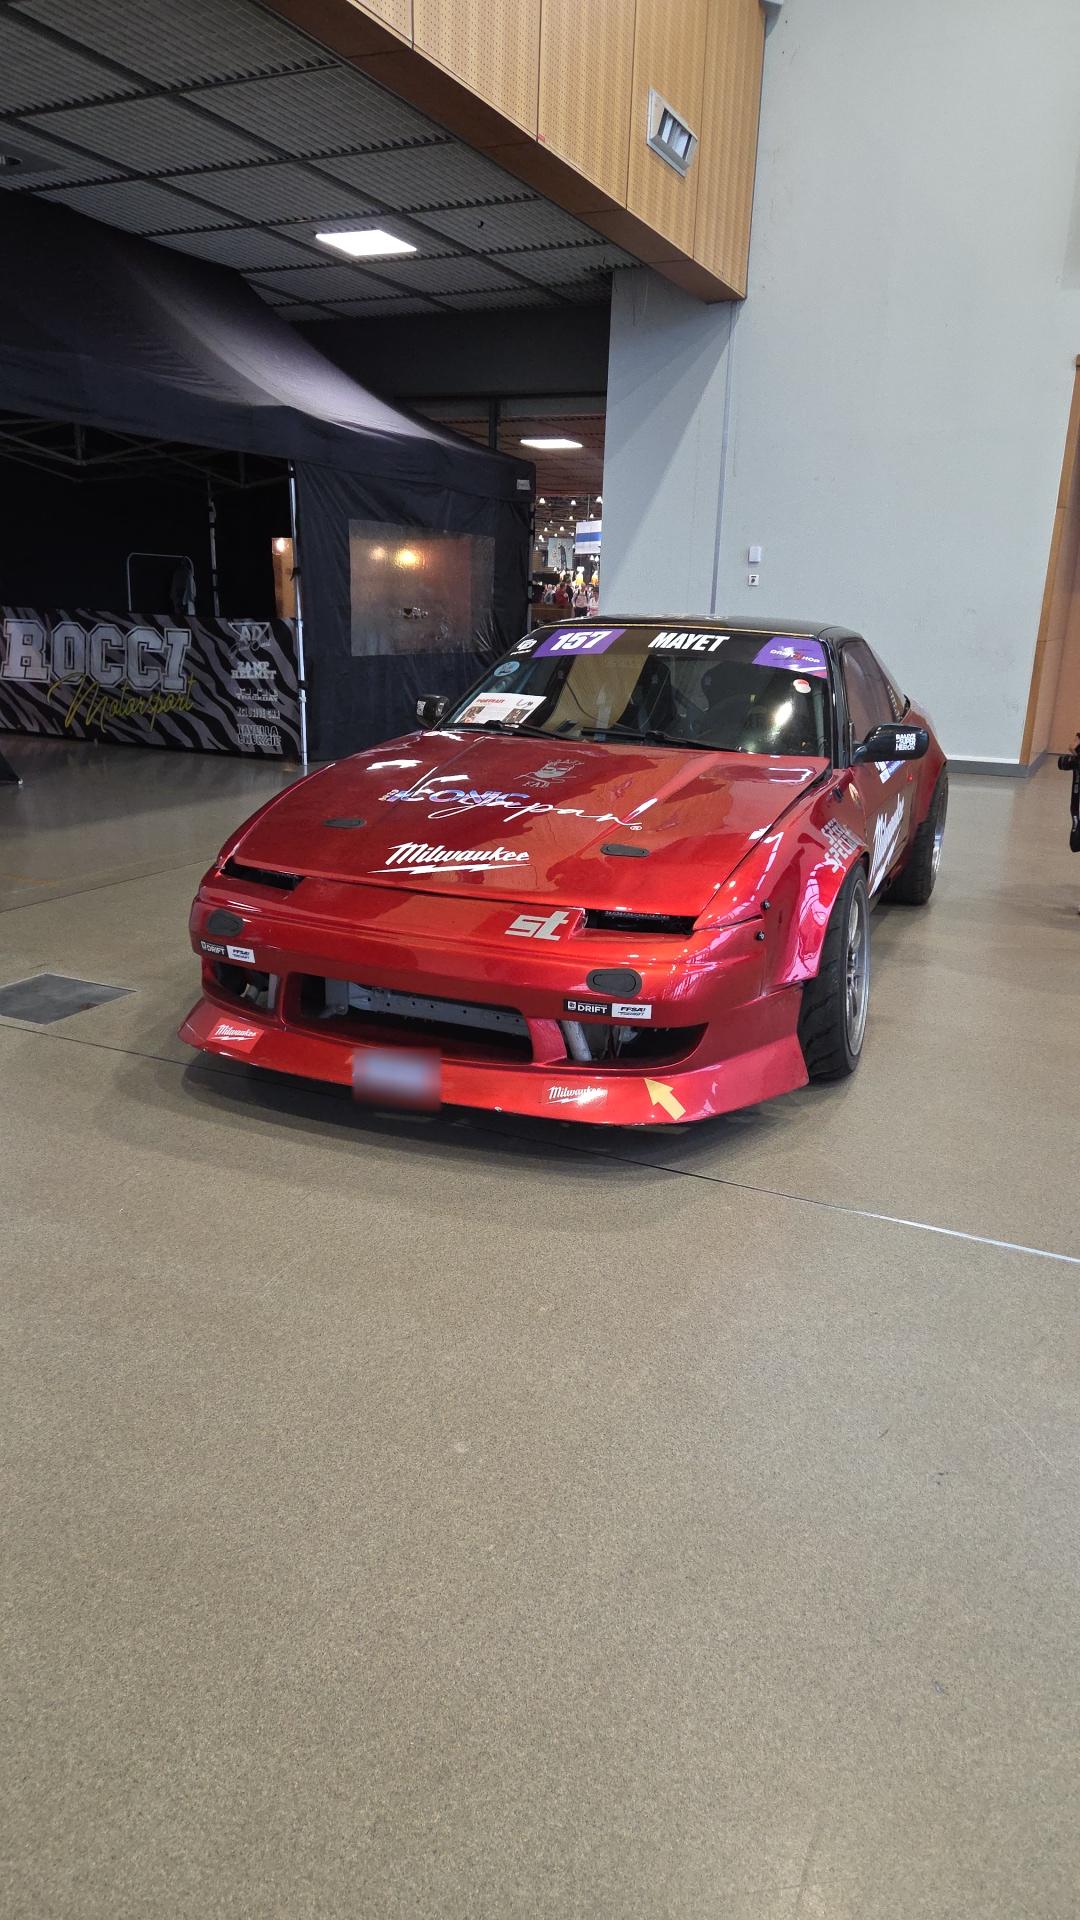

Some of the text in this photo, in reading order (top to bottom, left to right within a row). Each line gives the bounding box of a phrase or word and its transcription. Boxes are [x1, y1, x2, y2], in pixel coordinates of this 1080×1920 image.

[551, 631, 613, 650] 157
[648, 632, 730, 652] MAYET
[1, 618, 192, 693] ROCCI
[231, 670, 277, 680] HELMET
[47, 672, 197, 733] Motorsport
[386, 842, 530, 865] Milwaukee
[577, 1004, 608, 1014] DRIFT
